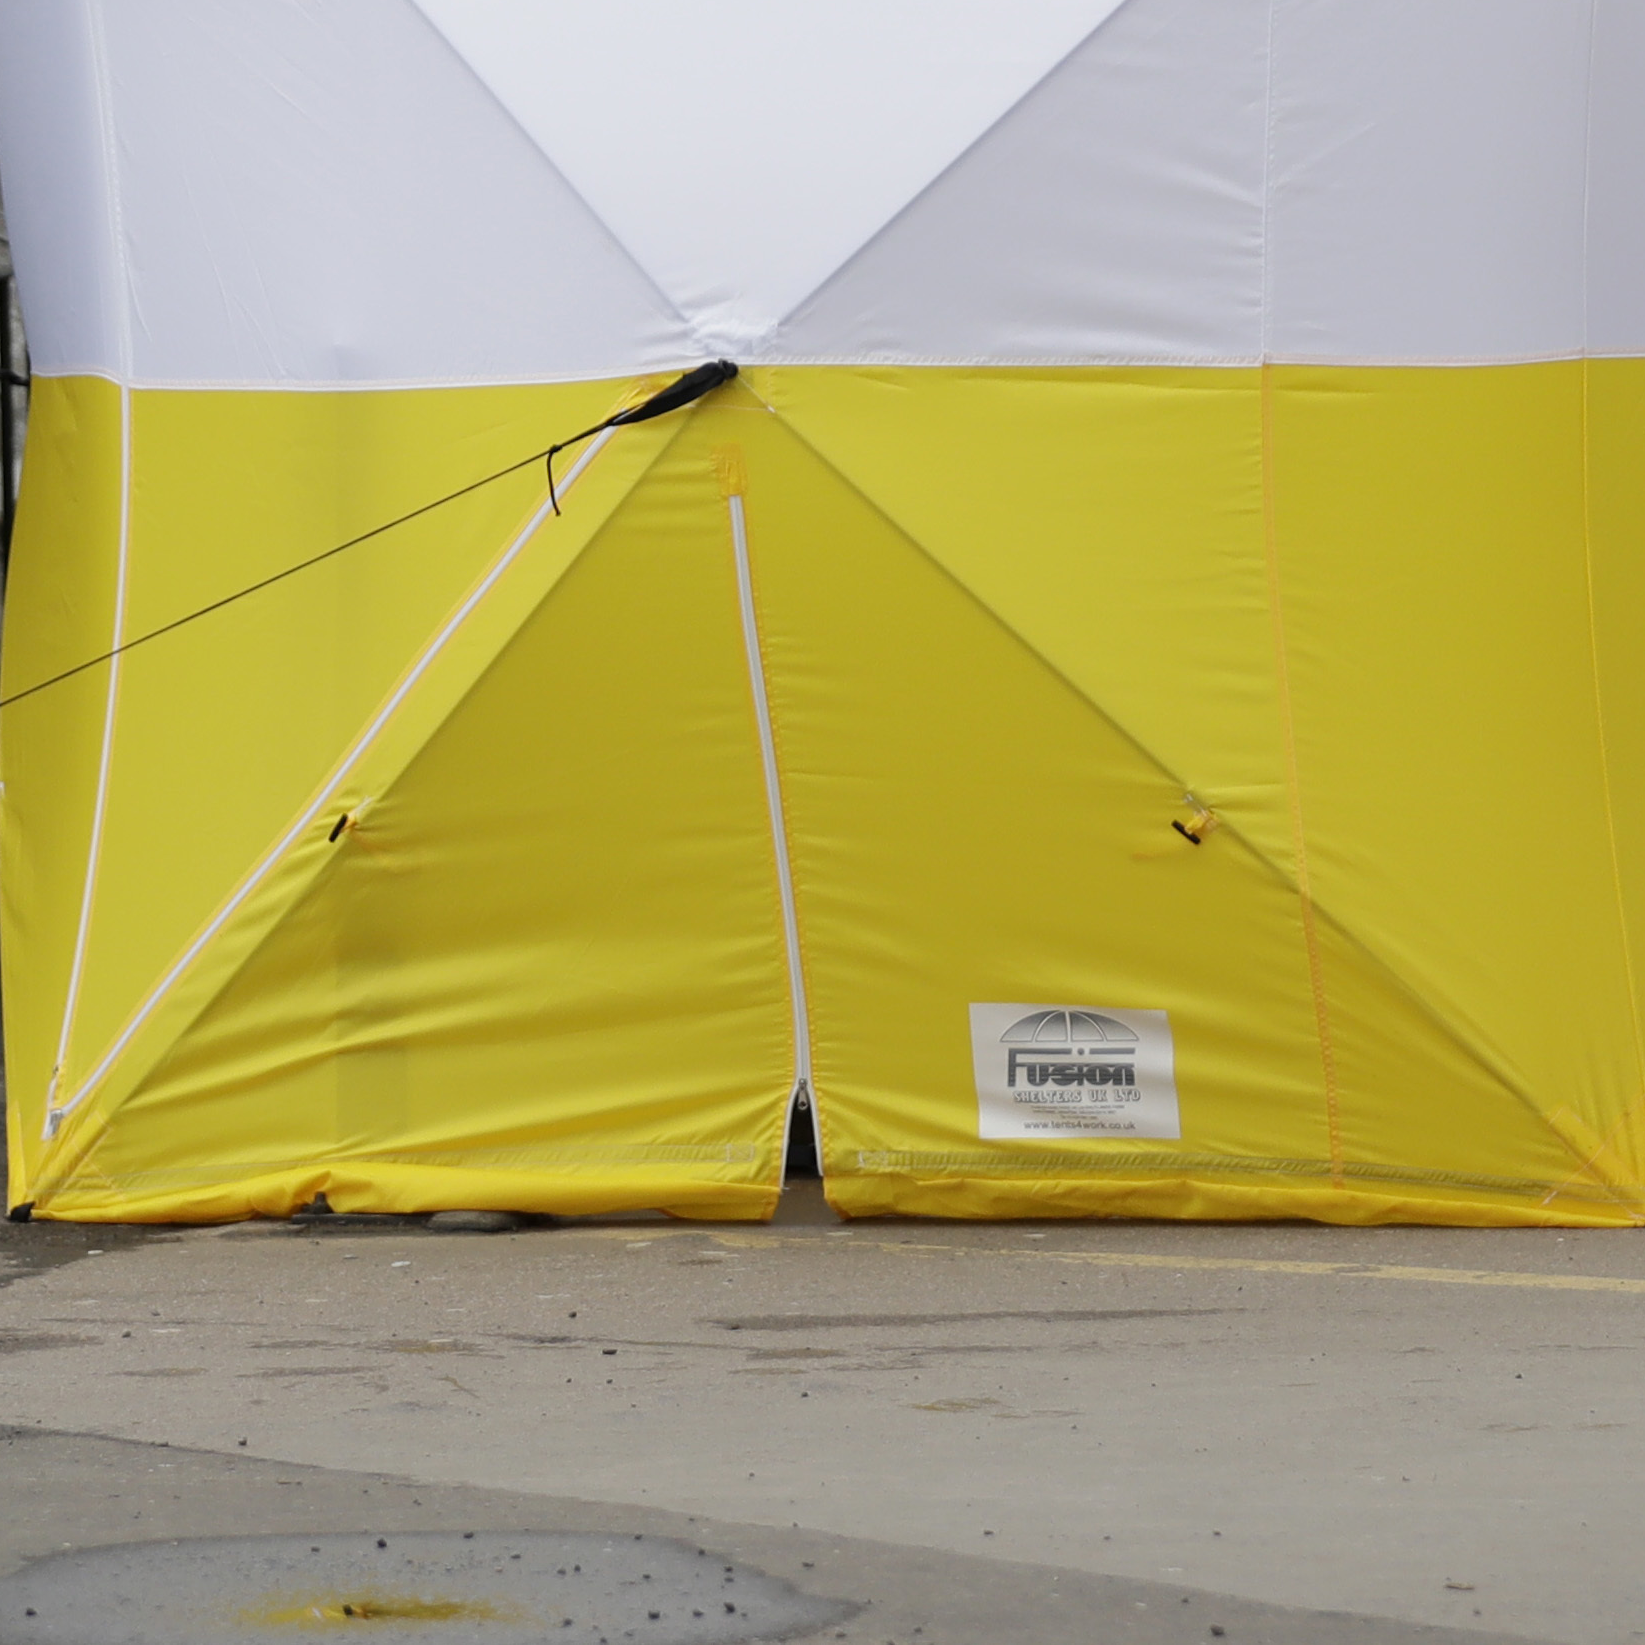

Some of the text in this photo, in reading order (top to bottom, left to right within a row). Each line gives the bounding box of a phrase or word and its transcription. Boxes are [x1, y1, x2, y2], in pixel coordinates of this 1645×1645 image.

[1012, 1089, 1141, 1104] SHELTERS UK LTD
[1023, 1120, 1136, 1131] www.tents4work.co.uk
